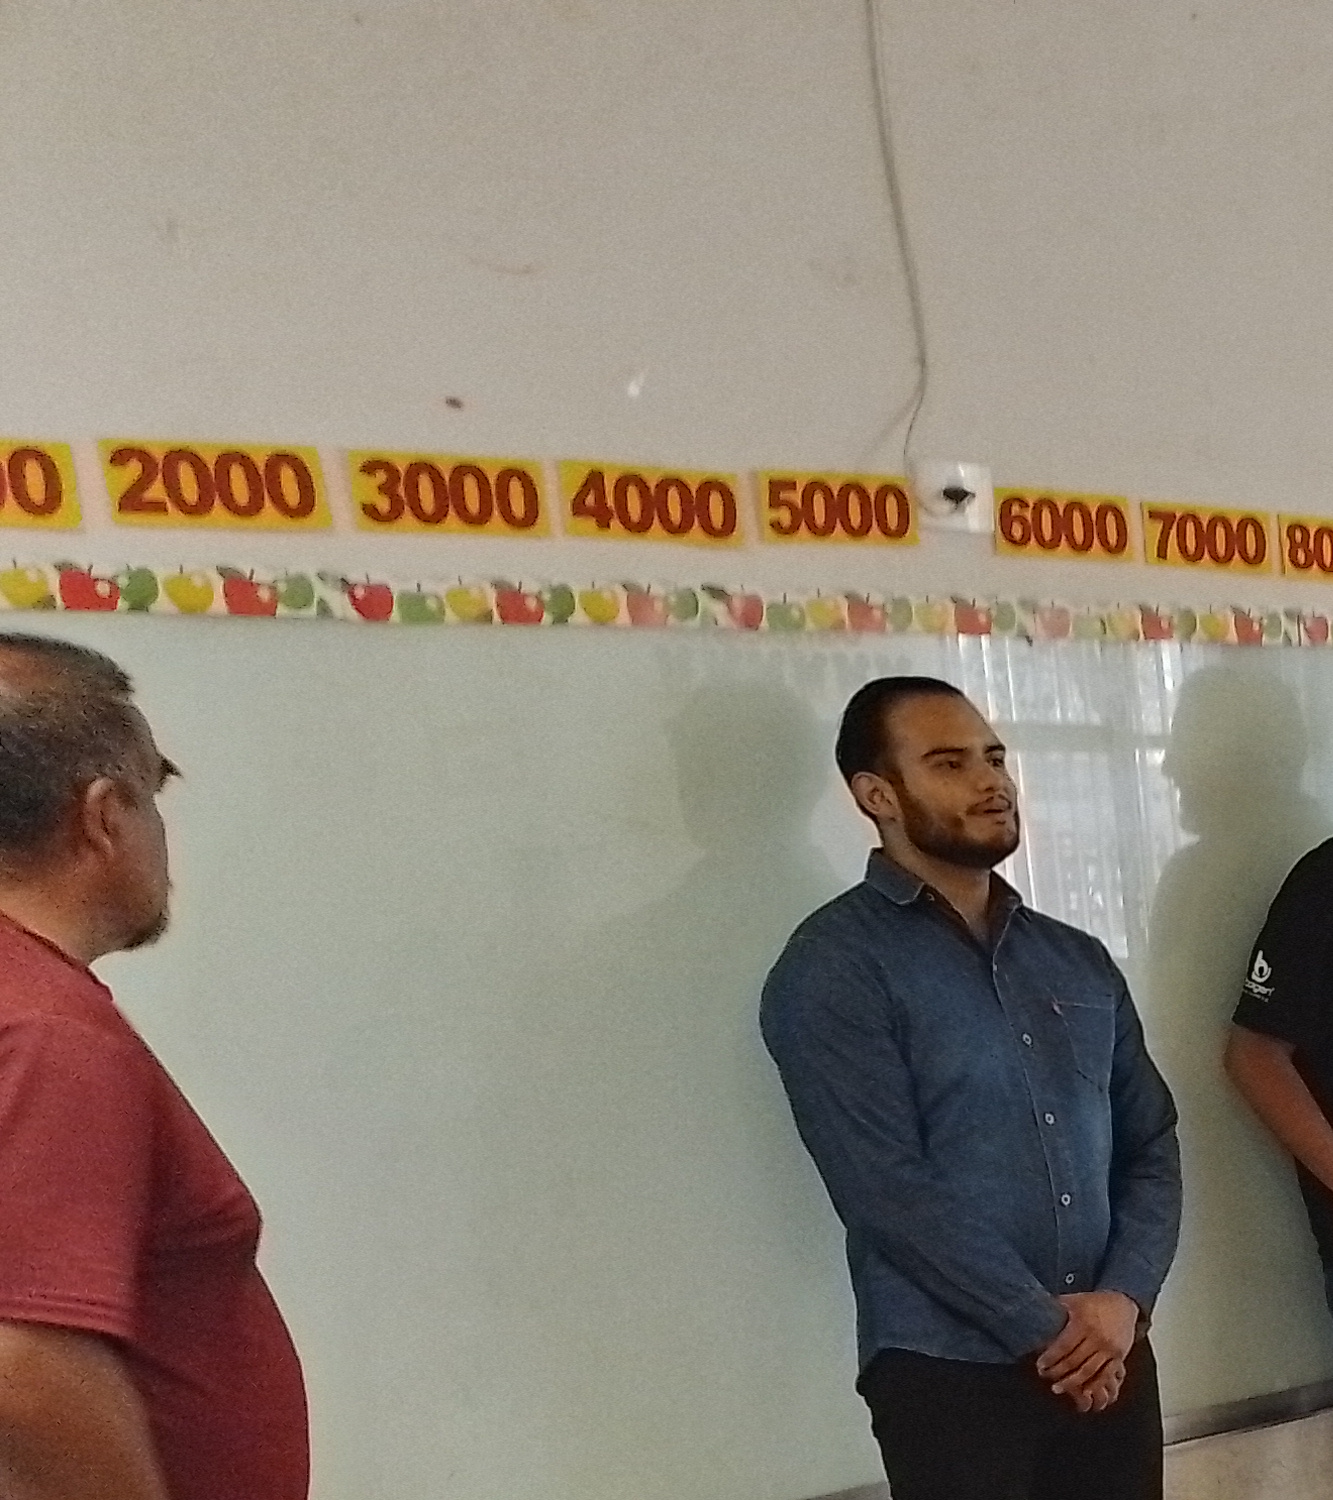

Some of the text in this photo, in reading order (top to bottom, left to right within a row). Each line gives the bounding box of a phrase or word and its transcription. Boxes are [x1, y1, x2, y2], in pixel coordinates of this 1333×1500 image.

[110, 447, 316, 519] 2000
[359, 459, 541, 529] 3000
[570, 469, 738, 539] 4000
[767, 479, 911, 540] 5000
[999, 497, 1128, 556] 6000
[1148, 509, 1267, 566] 7000
